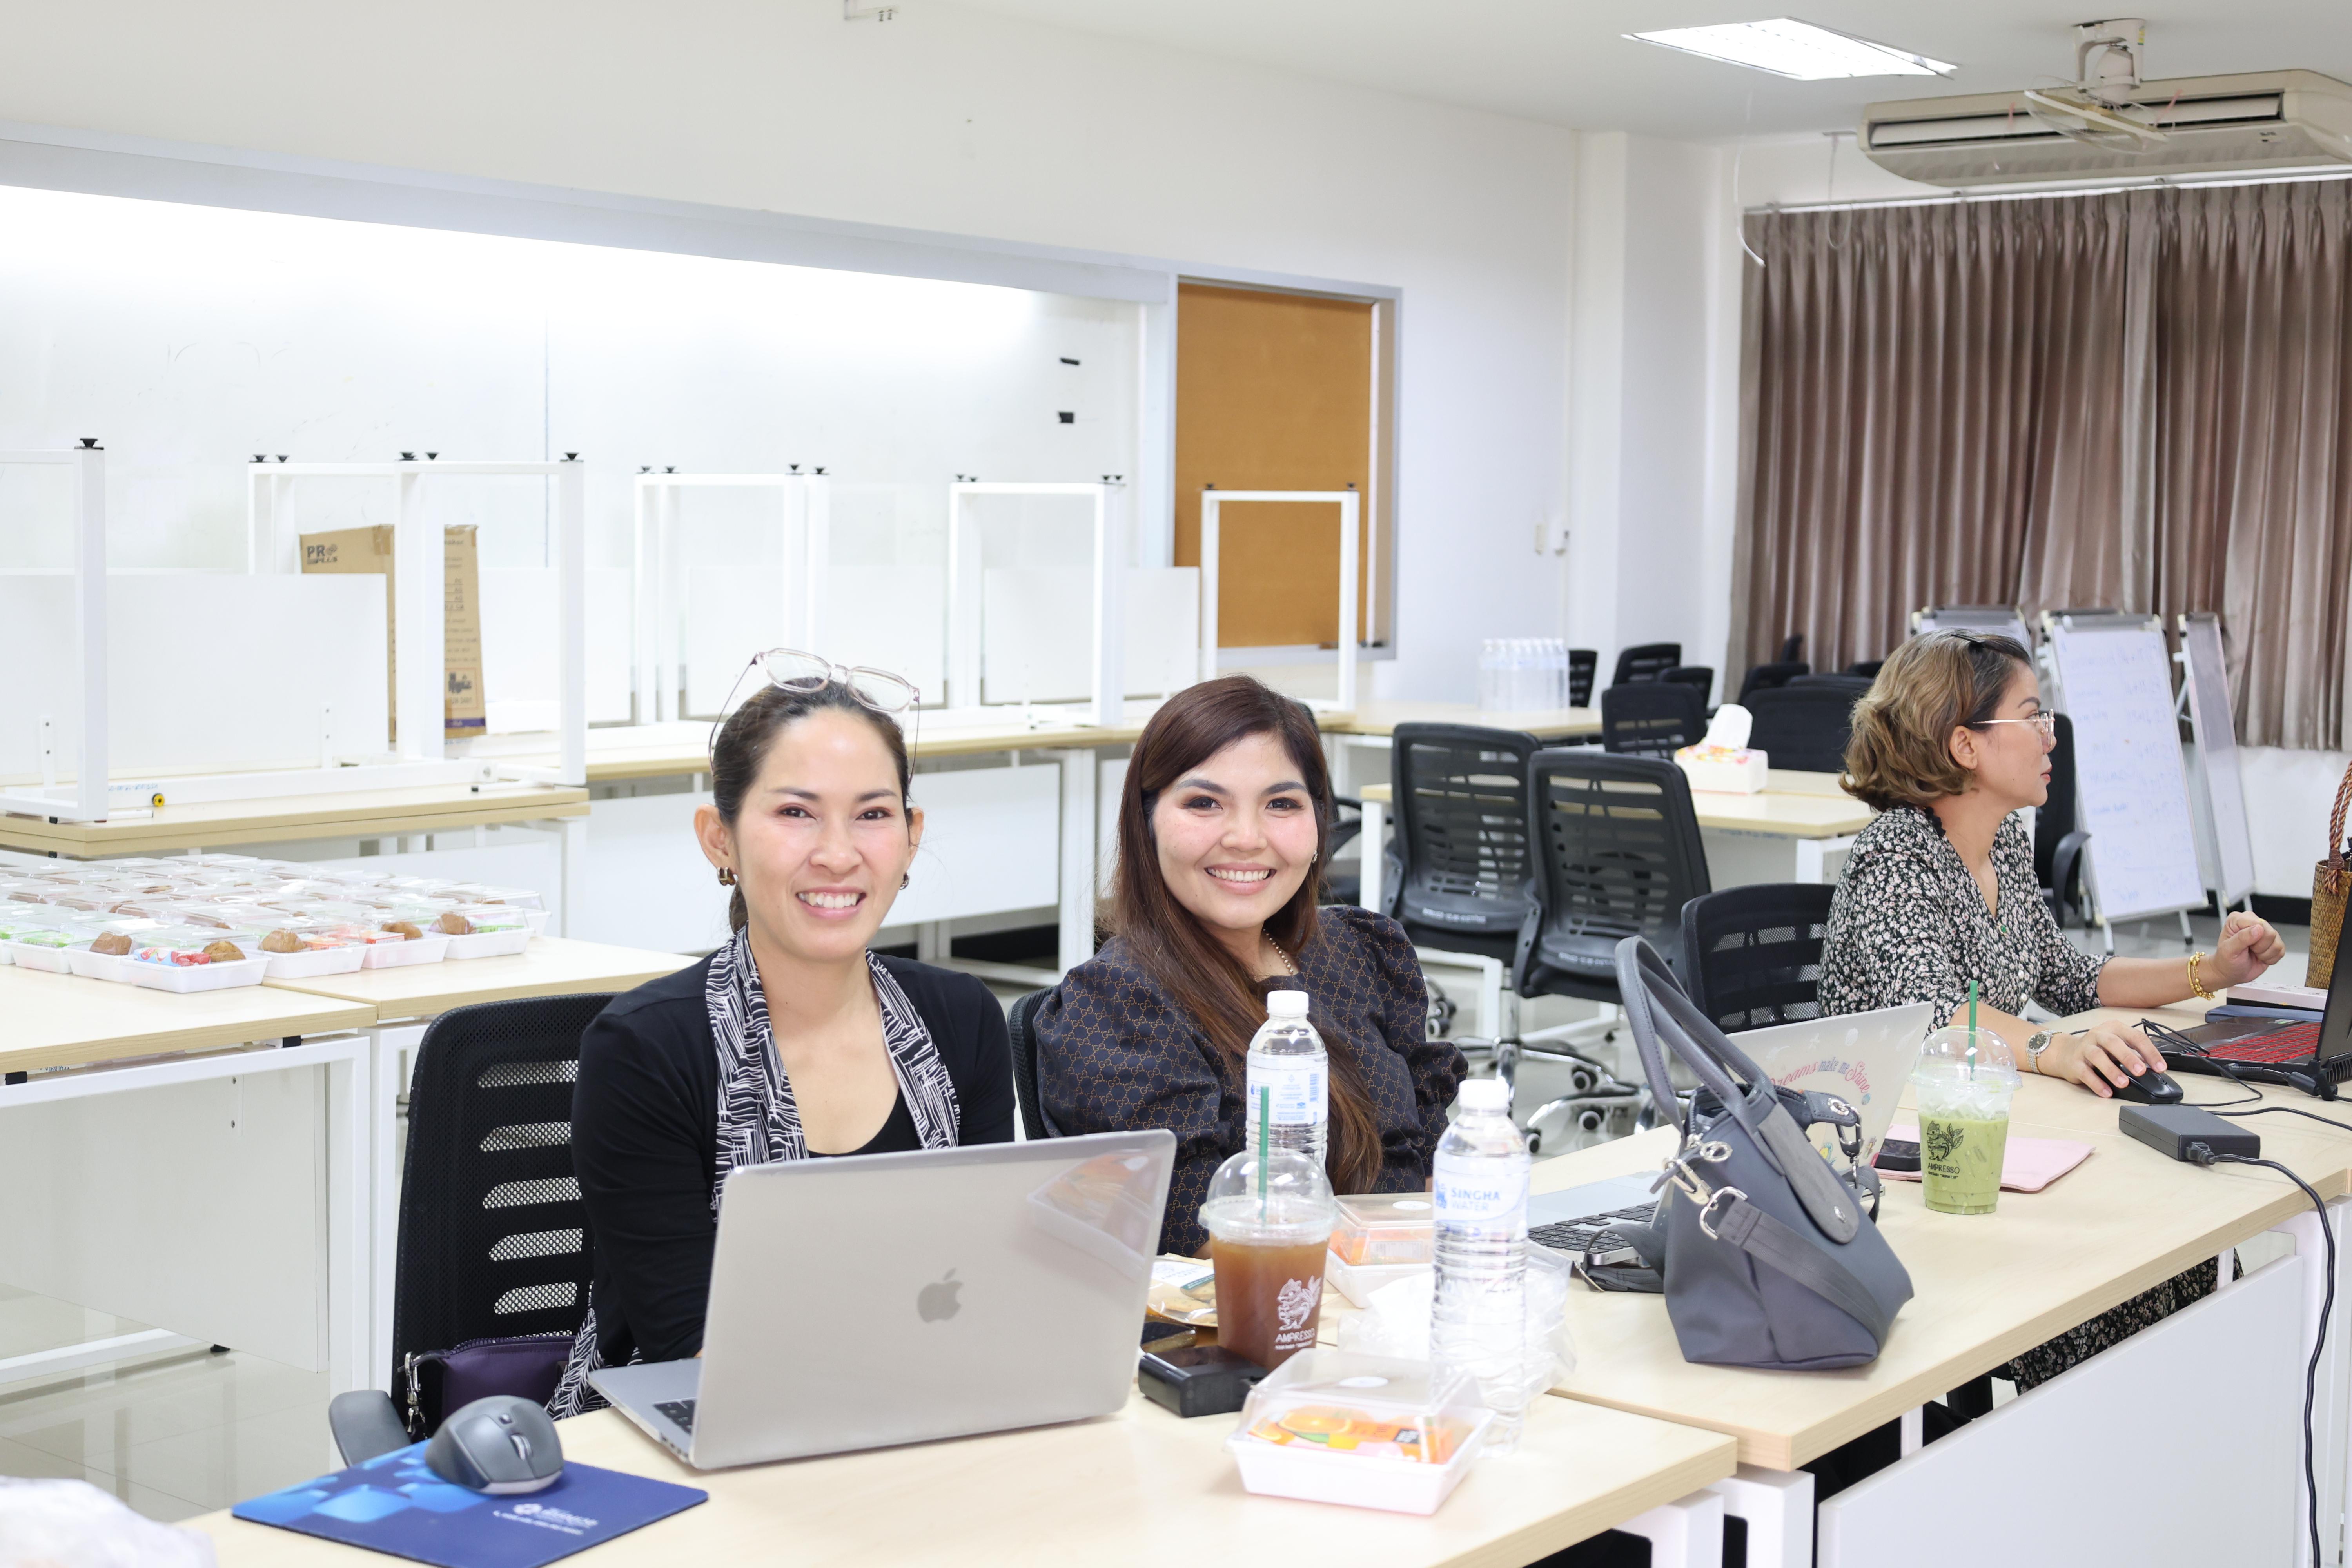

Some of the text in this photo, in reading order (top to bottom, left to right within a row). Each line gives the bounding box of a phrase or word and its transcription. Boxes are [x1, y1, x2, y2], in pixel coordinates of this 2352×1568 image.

[1818, 1057, 1839, 1072] make
[1837, 1062, 1850, 1075] me
[1845, 1061, 1870, 1094] Shine
[1928, 1163, 1960, 1174] AMPRESSO
[1452, 1188, 1500, 1200] SINGHA
[1452, 1200, 1489, 1211] WATER
